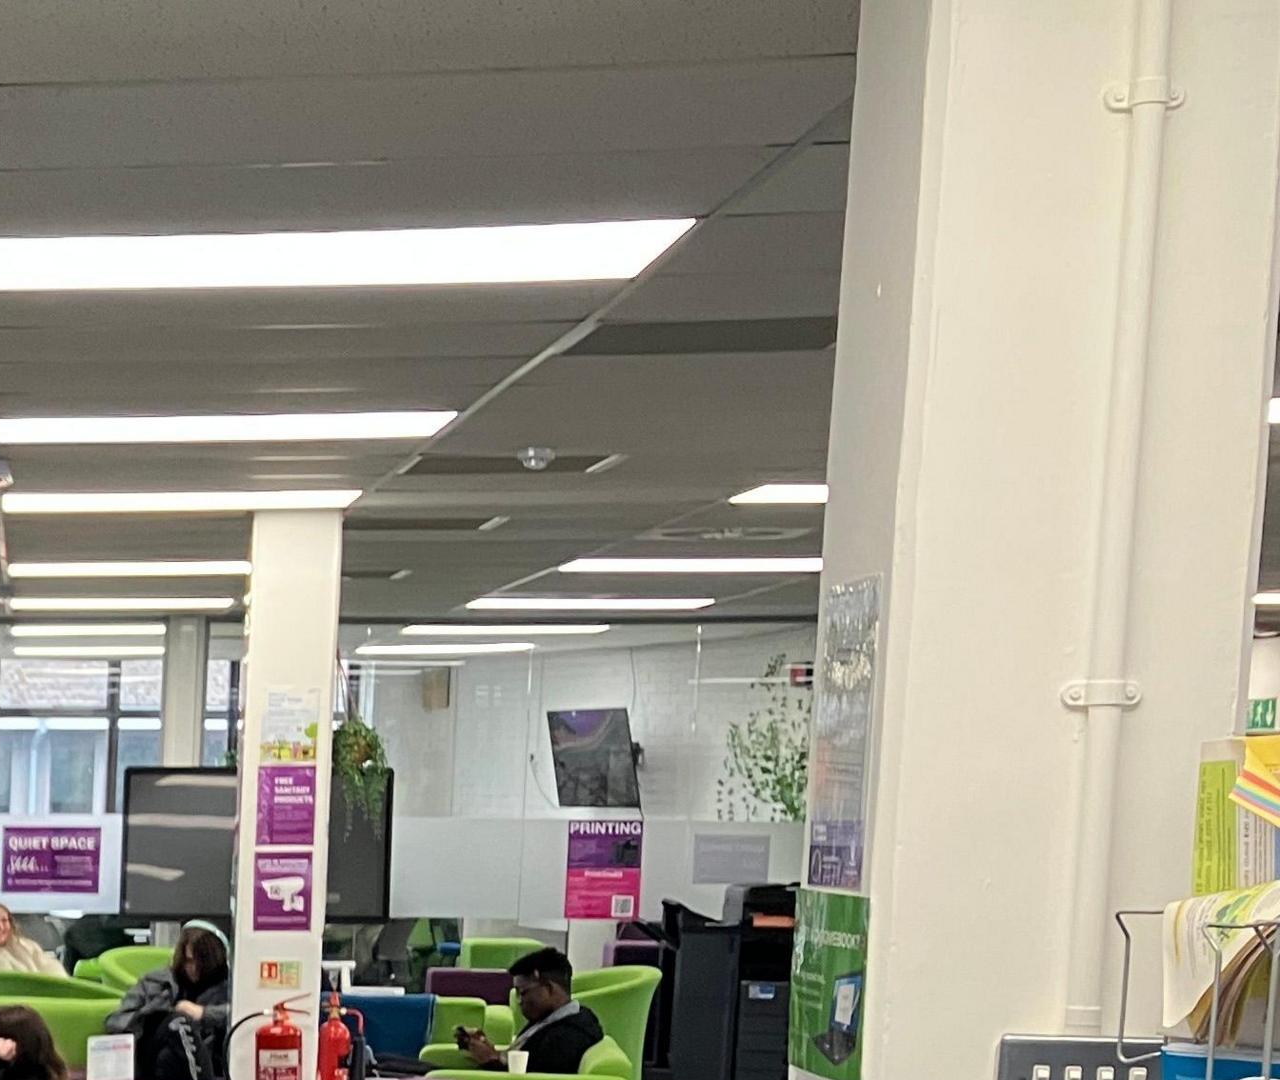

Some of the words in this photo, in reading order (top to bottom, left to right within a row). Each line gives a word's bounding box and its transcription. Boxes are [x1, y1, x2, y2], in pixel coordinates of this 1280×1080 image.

[569, 822, 641, 835] PRINTING
[8, 836, 49, 852] QUIET
[50, 836, 97, 851] SPACE
